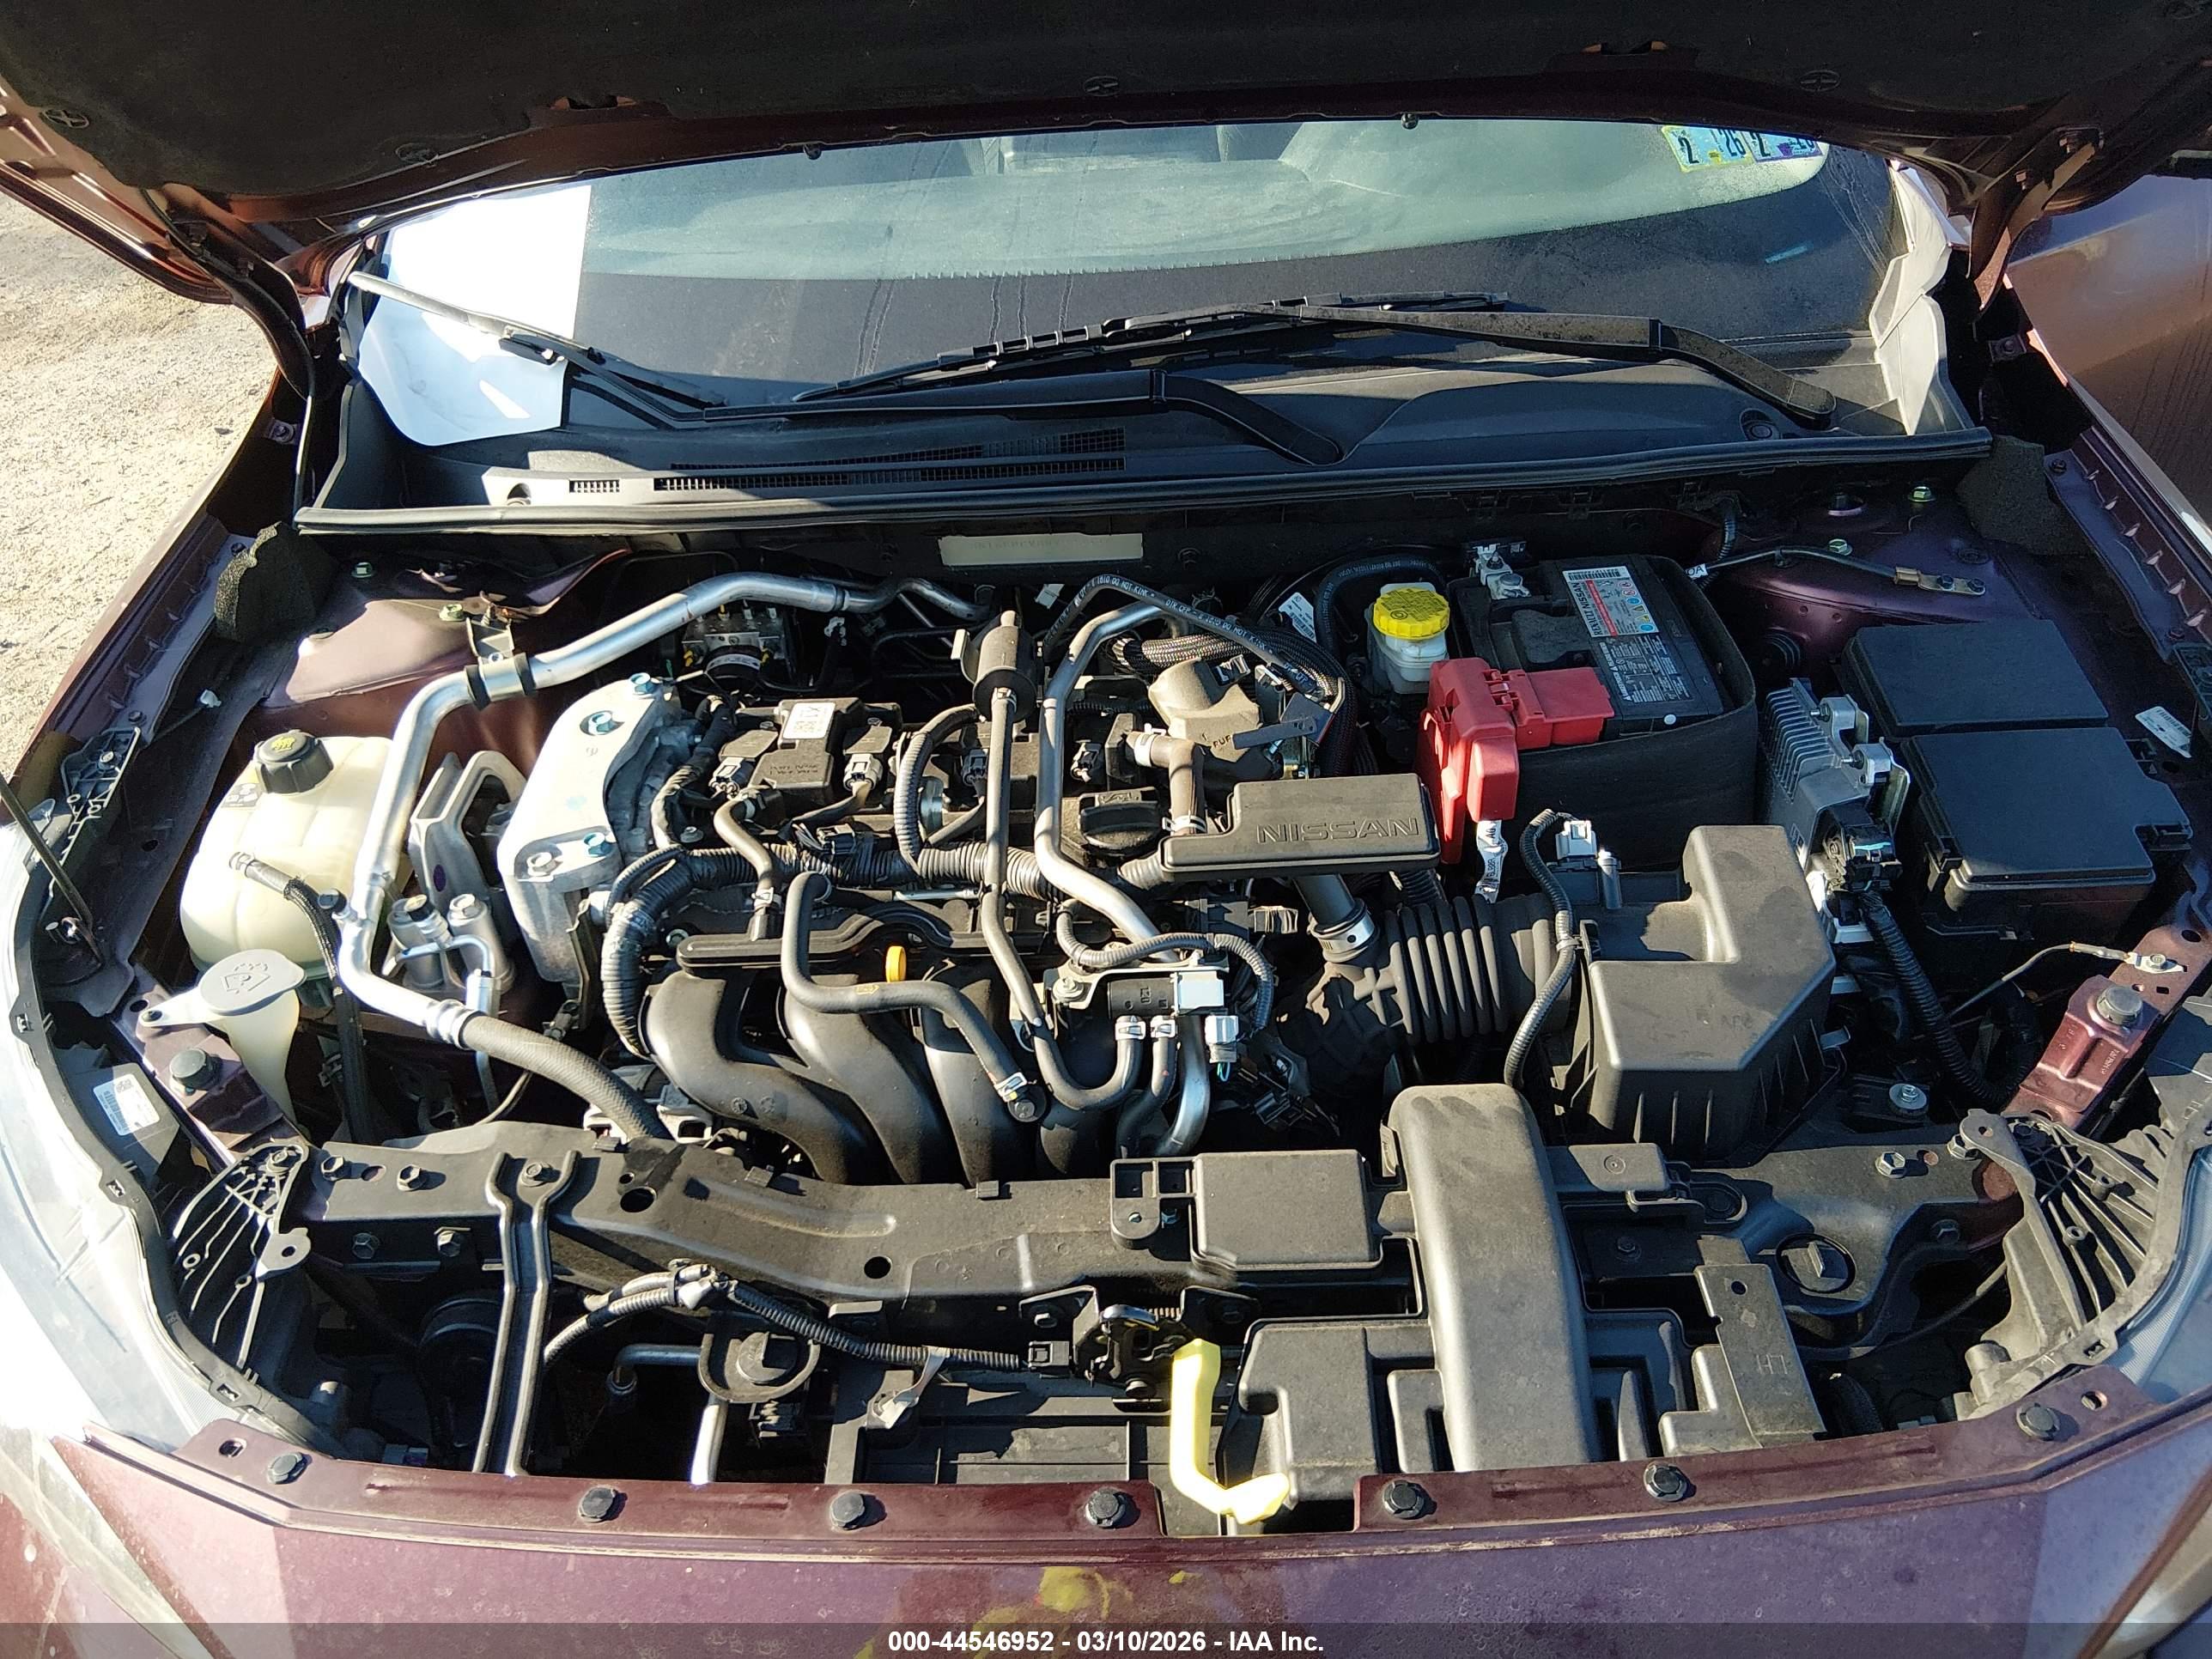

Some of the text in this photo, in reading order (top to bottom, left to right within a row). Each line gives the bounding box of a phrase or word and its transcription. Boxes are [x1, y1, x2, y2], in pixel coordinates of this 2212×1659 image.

[1678, 136, 1699, 164] 2
[1571, 582, 1590, 608] NISSAN
[1583, 610, 1602, 635] RENAULT
[1256, 817, 1419, 844] NISSAN
